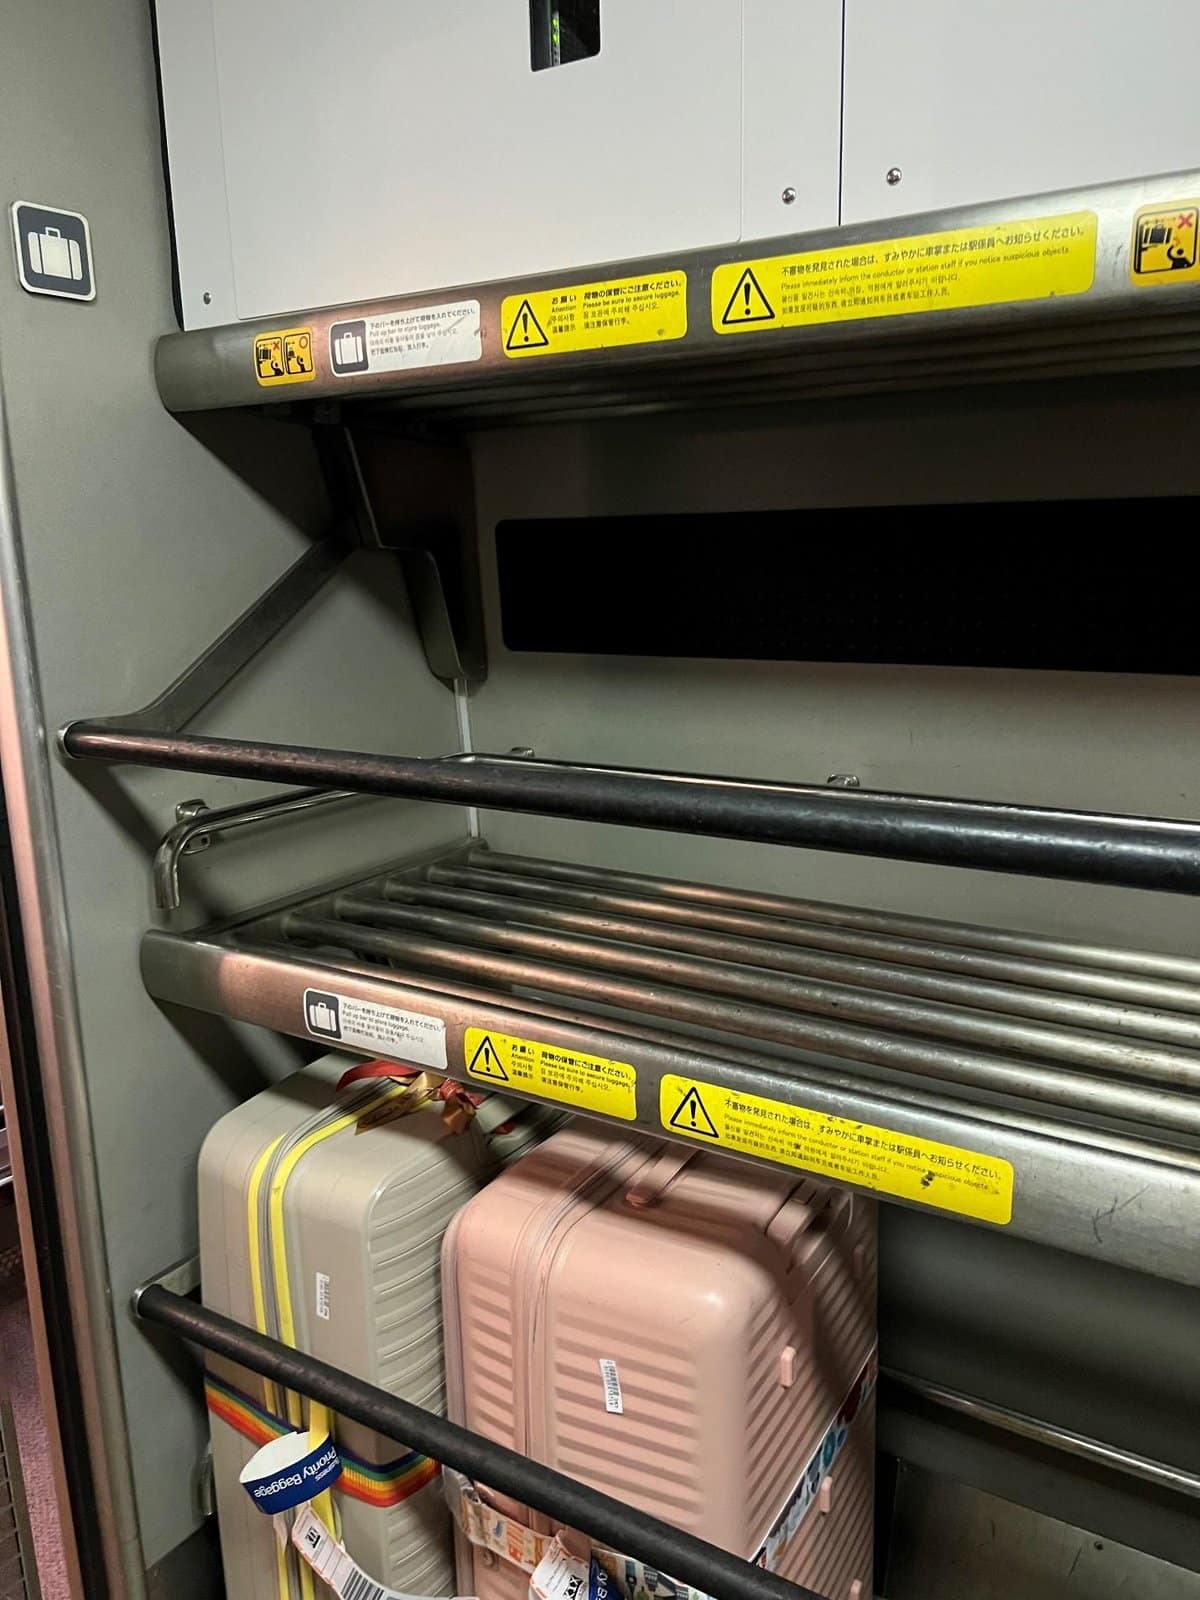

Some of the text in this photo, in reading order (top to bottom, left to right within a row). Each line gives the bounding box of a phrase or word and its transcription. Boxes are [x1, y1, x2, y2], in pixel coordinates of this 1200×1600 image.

[780, 280, 800, 290] Please
[802, 275, 837, 289] immediately
[838, 272, 859, 282] inform
[860, 271, 871, 280] the
[872, 266, 904, 278] conductor
[906, 266, 913, 274] or
[915, 262, 939, 273] station
[940, 259, 957, 269] staff
[964, 258, 977, 268] you
[978, 254, 1001, 264] notice
[1002, 249, 1040, 263] suspicious
[550, 287, 680, 314] Attention Please be sure to secure luggage.
[510, 1052, 535, 1063] Attention
[539, 1059, 557, 1069] Please
[557, 1063, 566, 1071] be
[566, 1066, 579, 1075] sure
[586, 1071, 605, 1081] secure
[253, 1446, 337, 1498] Priority Baggage
